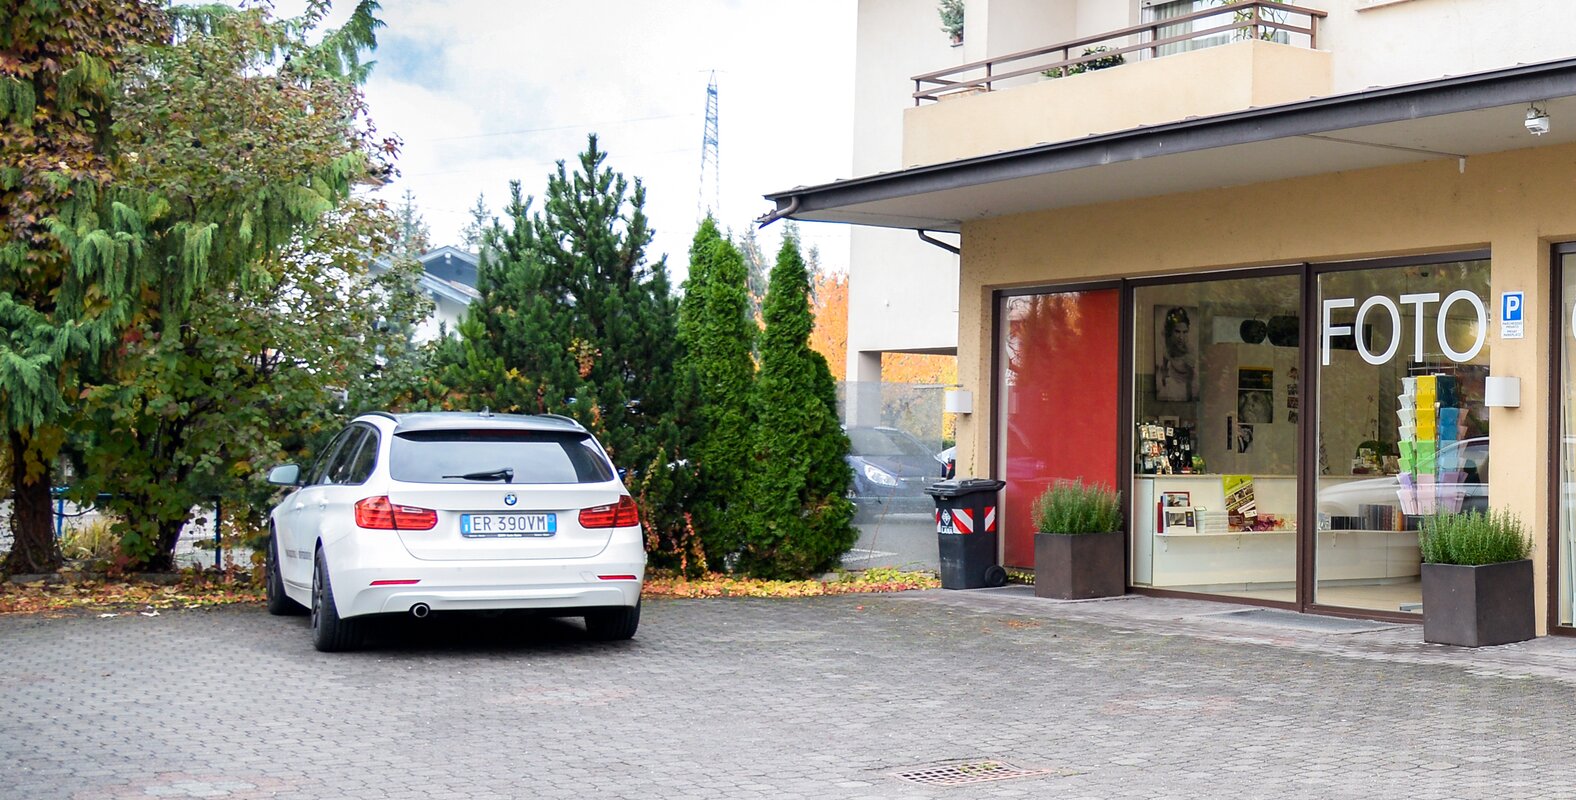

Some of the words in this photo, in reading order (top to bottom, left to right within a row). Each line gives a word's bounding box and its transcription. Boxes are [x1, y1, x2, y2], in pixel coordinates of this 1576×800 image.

[1506, 296, 1520, 319] P
[1322, 289, 1487, 366] FOTO
[473, 516, 492, 531] ER
[498, 515, 546, 531] 390VM
